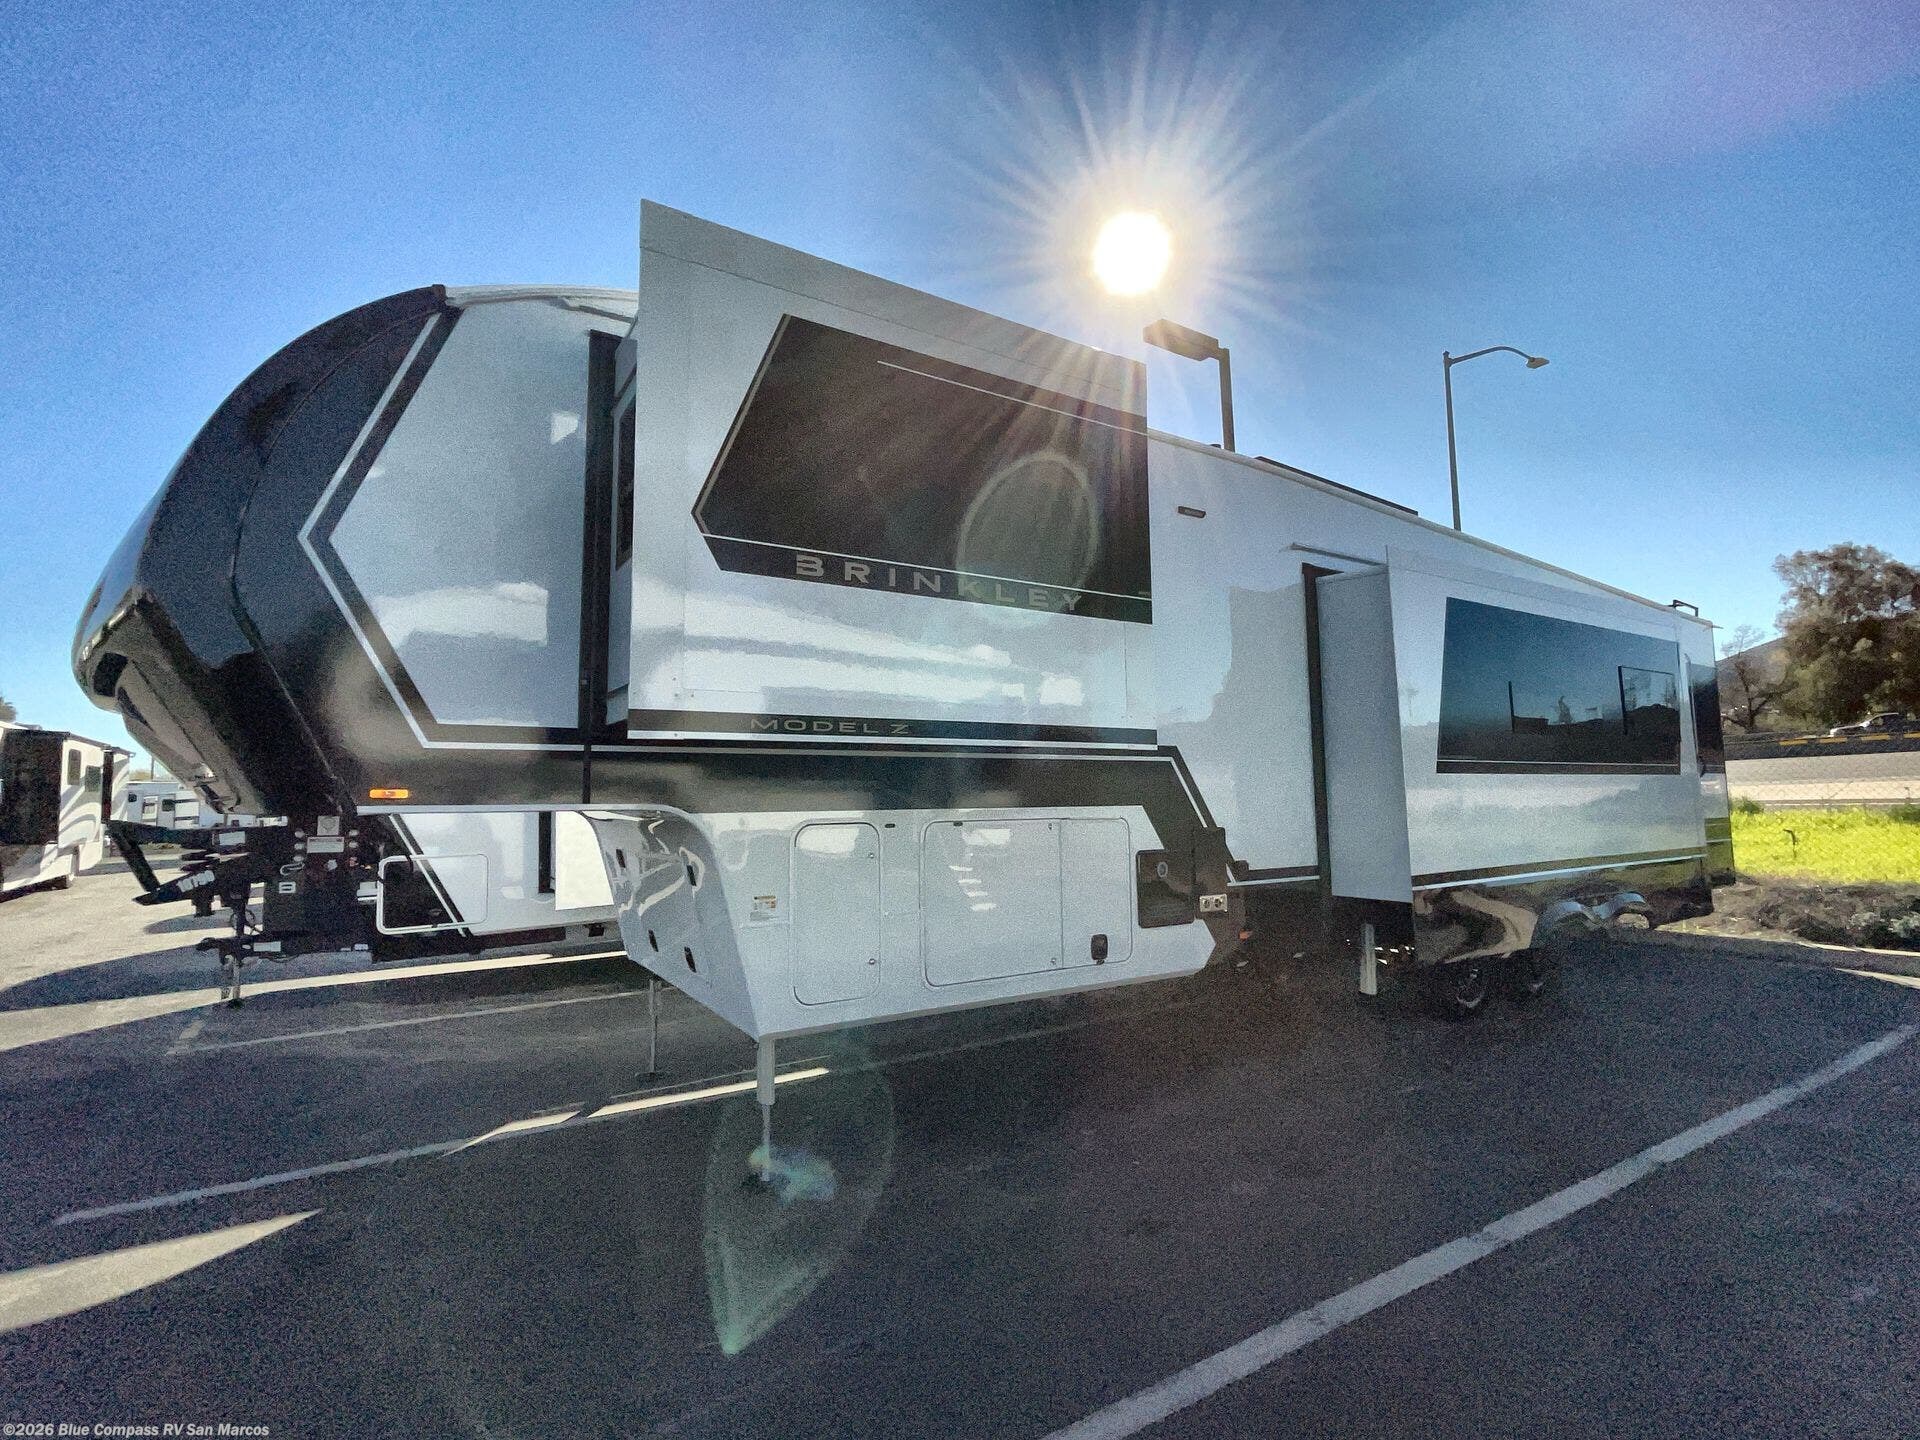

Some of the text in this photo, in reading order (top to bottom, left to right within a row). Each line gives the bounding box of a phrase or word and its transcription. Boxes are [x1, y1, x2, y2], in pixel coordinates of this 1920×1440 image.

[795, 554, 1082, 611] BRINKLEY
[750, 718, 909, 735] MODEL Z
